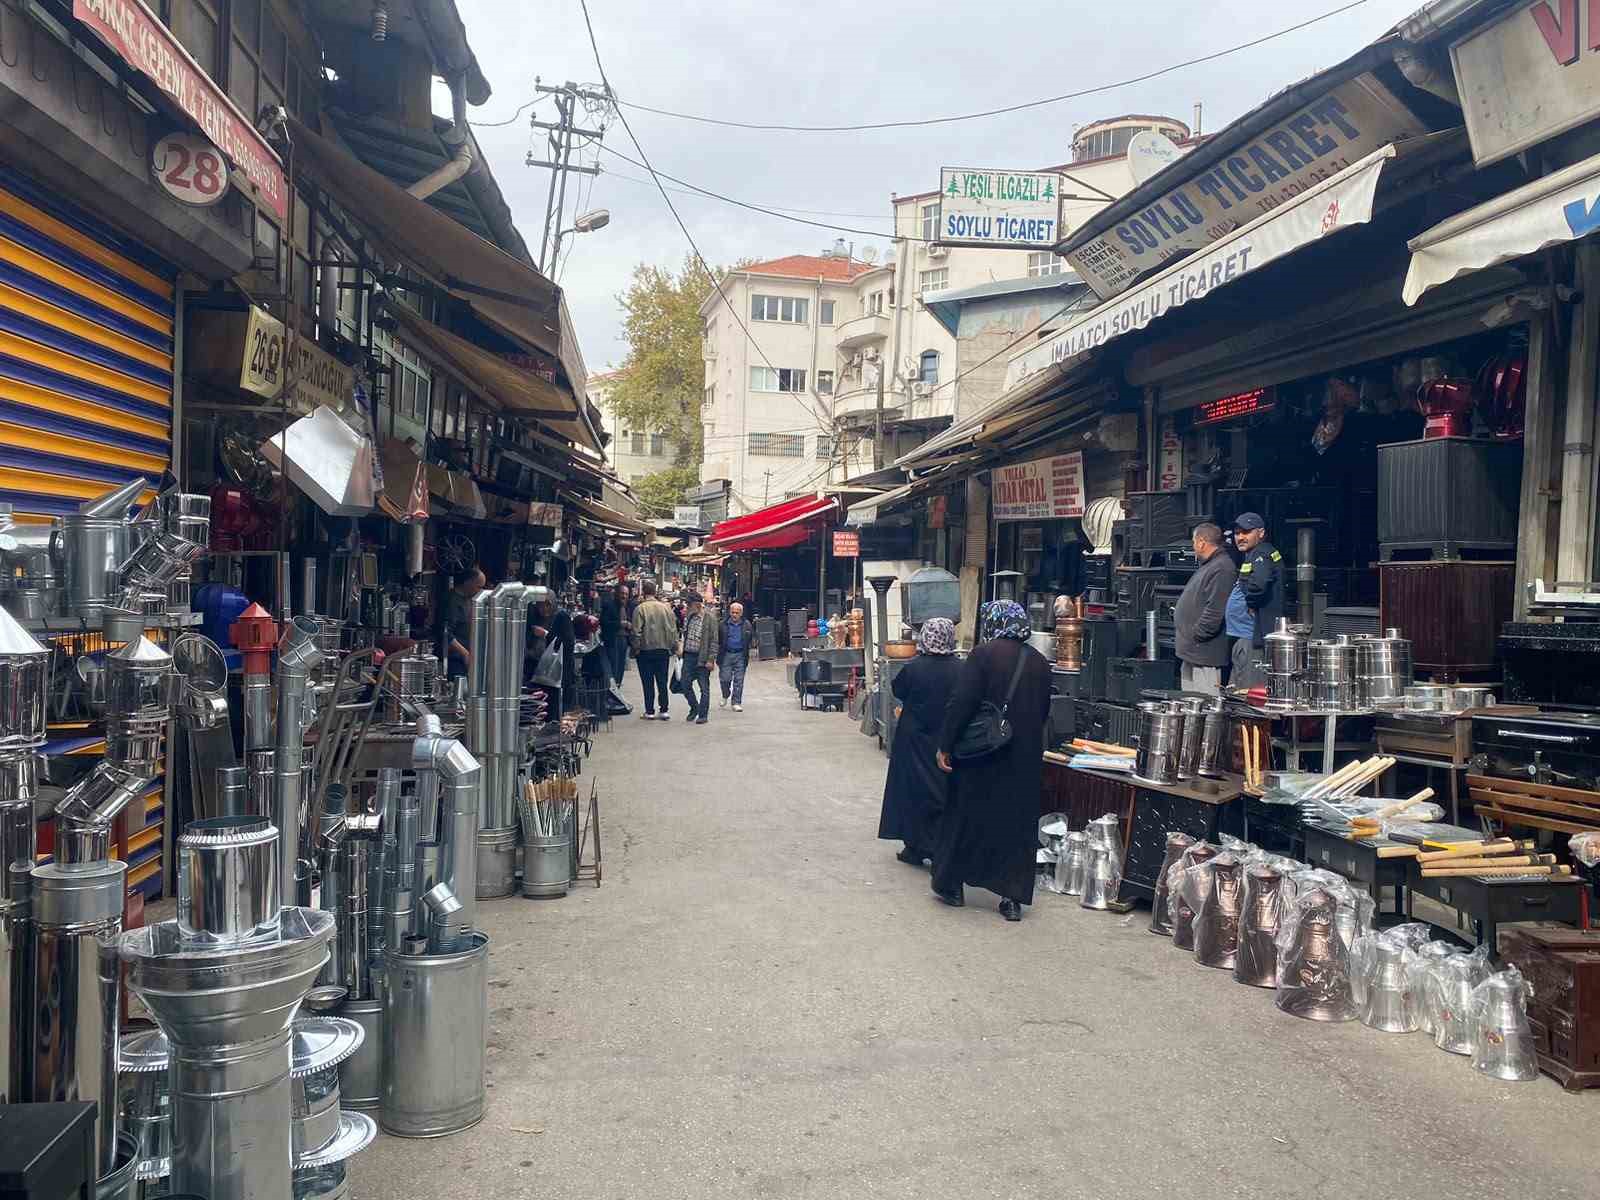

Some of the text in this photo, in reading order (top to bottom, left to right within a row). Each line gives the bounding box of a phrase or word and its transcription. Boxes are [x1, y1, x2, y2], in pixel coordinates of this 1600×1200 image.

[165, 143, 221, 195] 28
[947, 211, 1054, 241] SOYLU TİCARET
[1116, 193, 1204, 255] SOYLU
[1112, 293, 1162, 337] SOYLU
[1168, 246, 1253, 306] TİCARET
